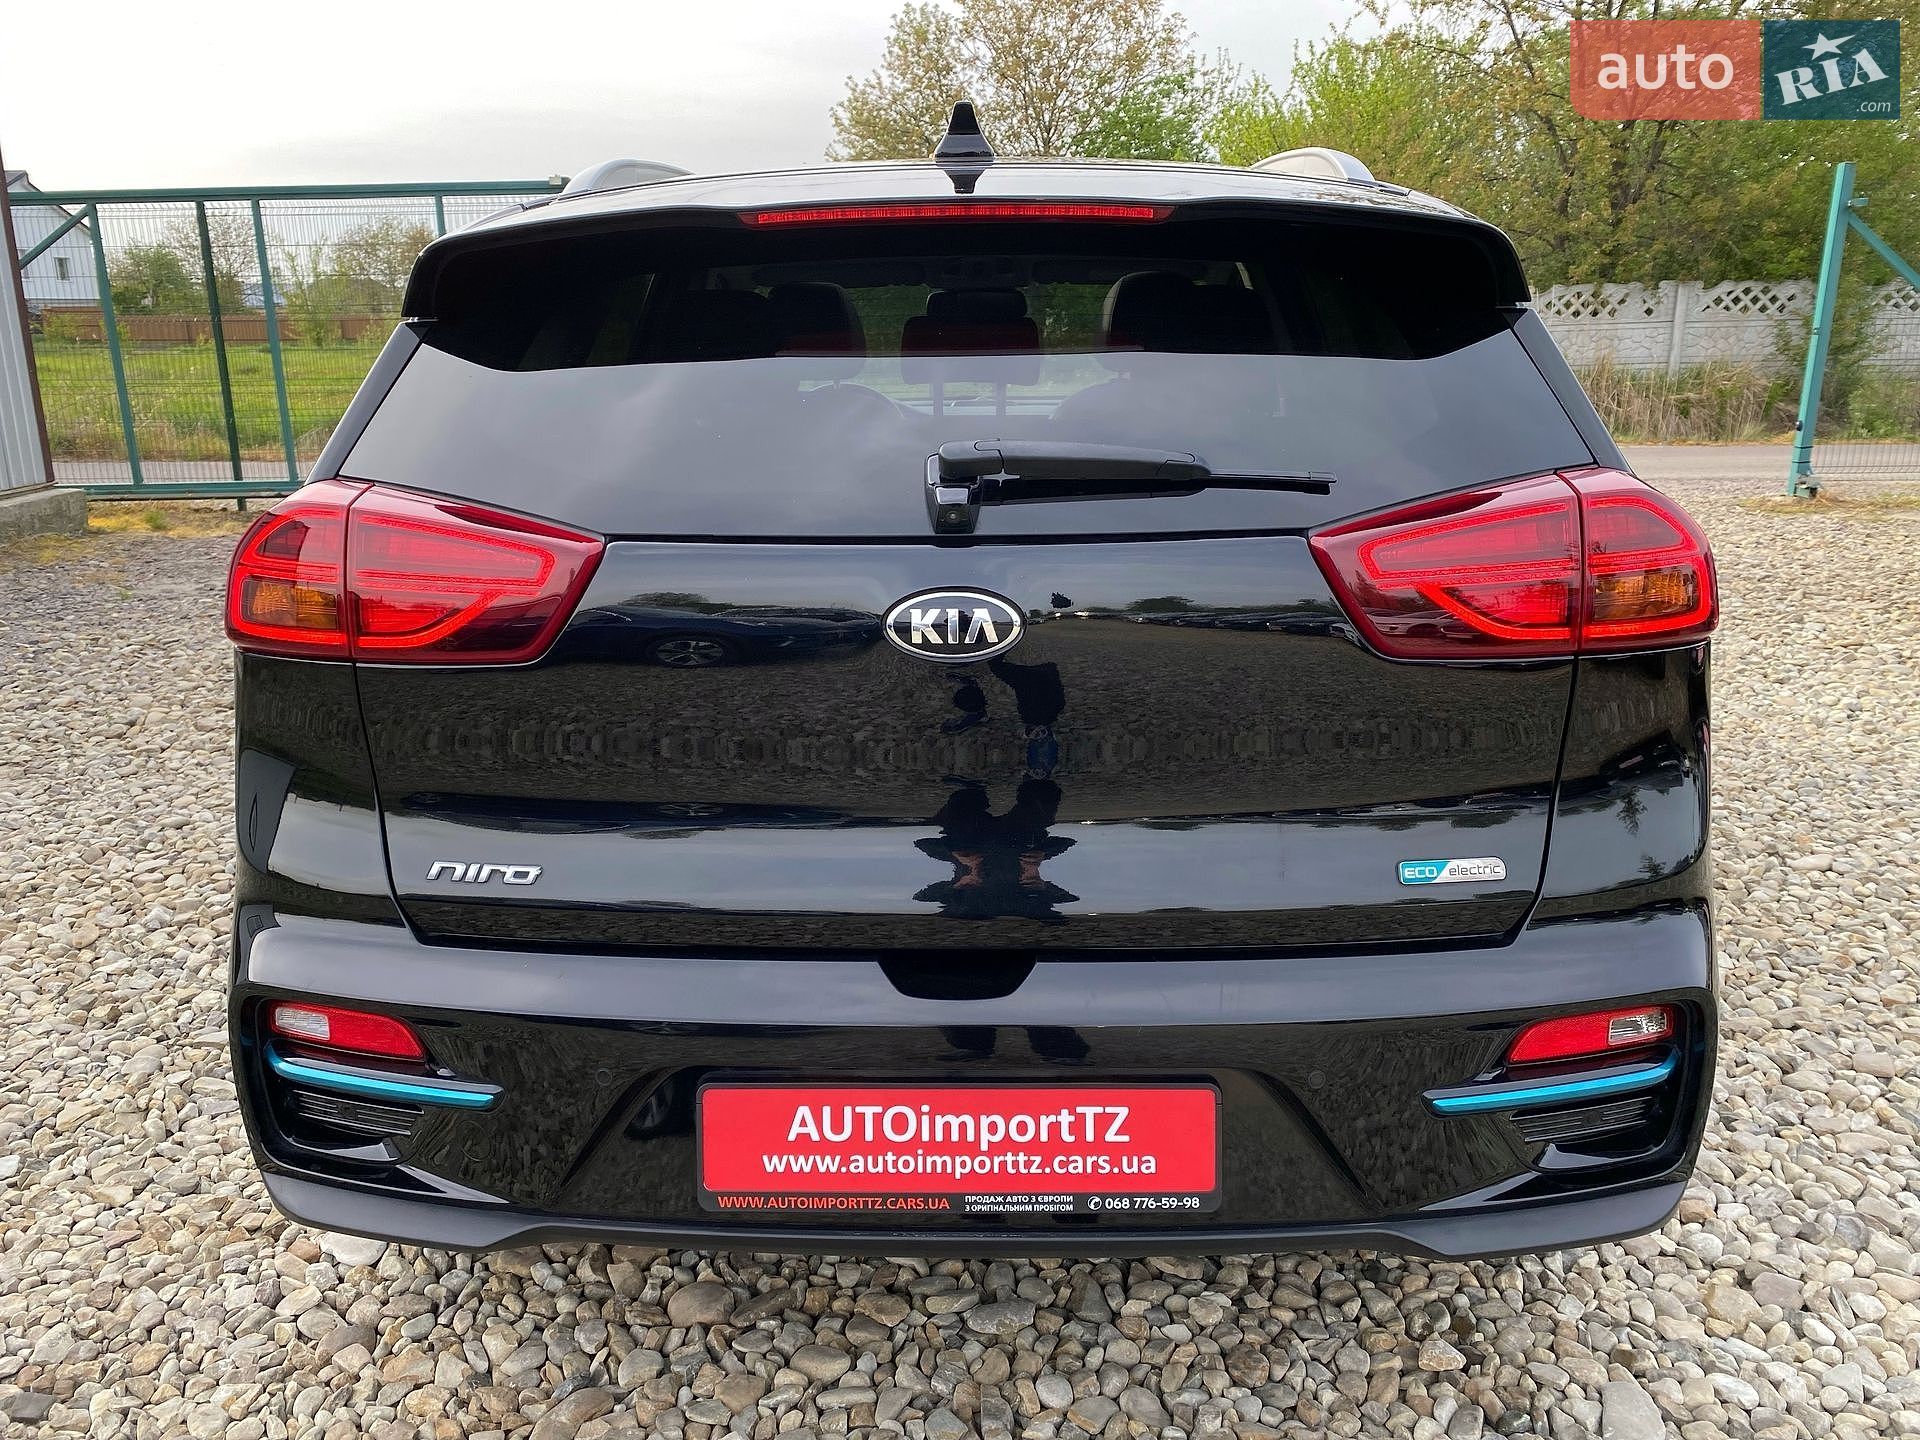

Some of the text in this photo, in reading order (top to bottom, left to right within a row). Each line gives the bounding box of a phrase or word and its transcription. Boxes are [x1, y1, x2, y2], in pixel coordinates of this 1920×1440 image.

[909, 608, 999, 644] KIA
[1448, 864, 1502, 876] electric
[787, 1105, 1131, 1151] AUTOimportTZ
[762, 1149, 1156, 1179] www.autoimporttz.cars.ua
[718, 1196, 950, 1210] WWW.AUTOIMPORTTZ.CARS.UA
[965, 1195, 1004, 1204] ПРОДАЖ
[1006, 1195, 1029, 1204] АВТО
[1038, 1195, 1073, 1203] ЄВРОПИ
[1105, 1197, 1200, 1209] 068 776-59-98
